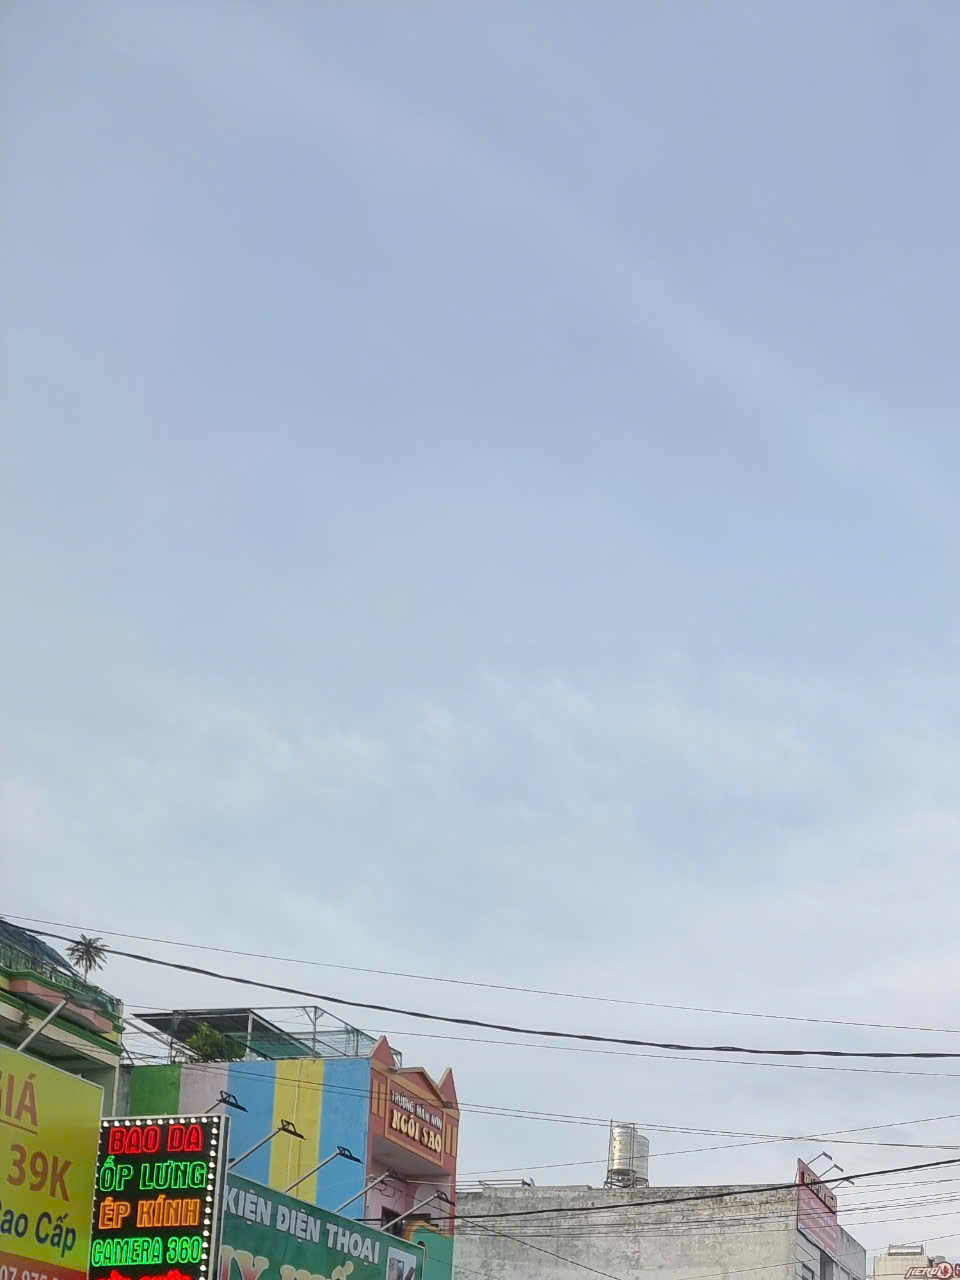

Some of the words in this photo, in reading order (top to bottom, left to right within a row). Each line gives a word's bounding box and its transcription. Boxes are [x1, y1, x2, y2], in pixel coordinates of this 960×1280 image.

[108, 1126, 162, 1155] BAO
[167, 1124, 204, 1152] DA
[392, 1109, 419, 1141] NGÔI
[422, 1127, 442, 1153] SAO
[7, 1143, 72, 1202] 39K
[100, 1155, 134, 1192] ỐP
[139, 1160, 208, 1190] LƯNG
[98, 1197, 131, 1230] ÉP
[136, 1194, 201, 1228] KÍNH
[224, 1185, 272, 1225] KIỆN
[276, 1204, 321, 1243] ĐIỆN
[326, 1222, 380, 1266] THOẠI
[34, 1211, 76, 1258] Cấp
[91, 1236, 163, 1267] CAMERA
[166, 1236, 202, 1263] 360
